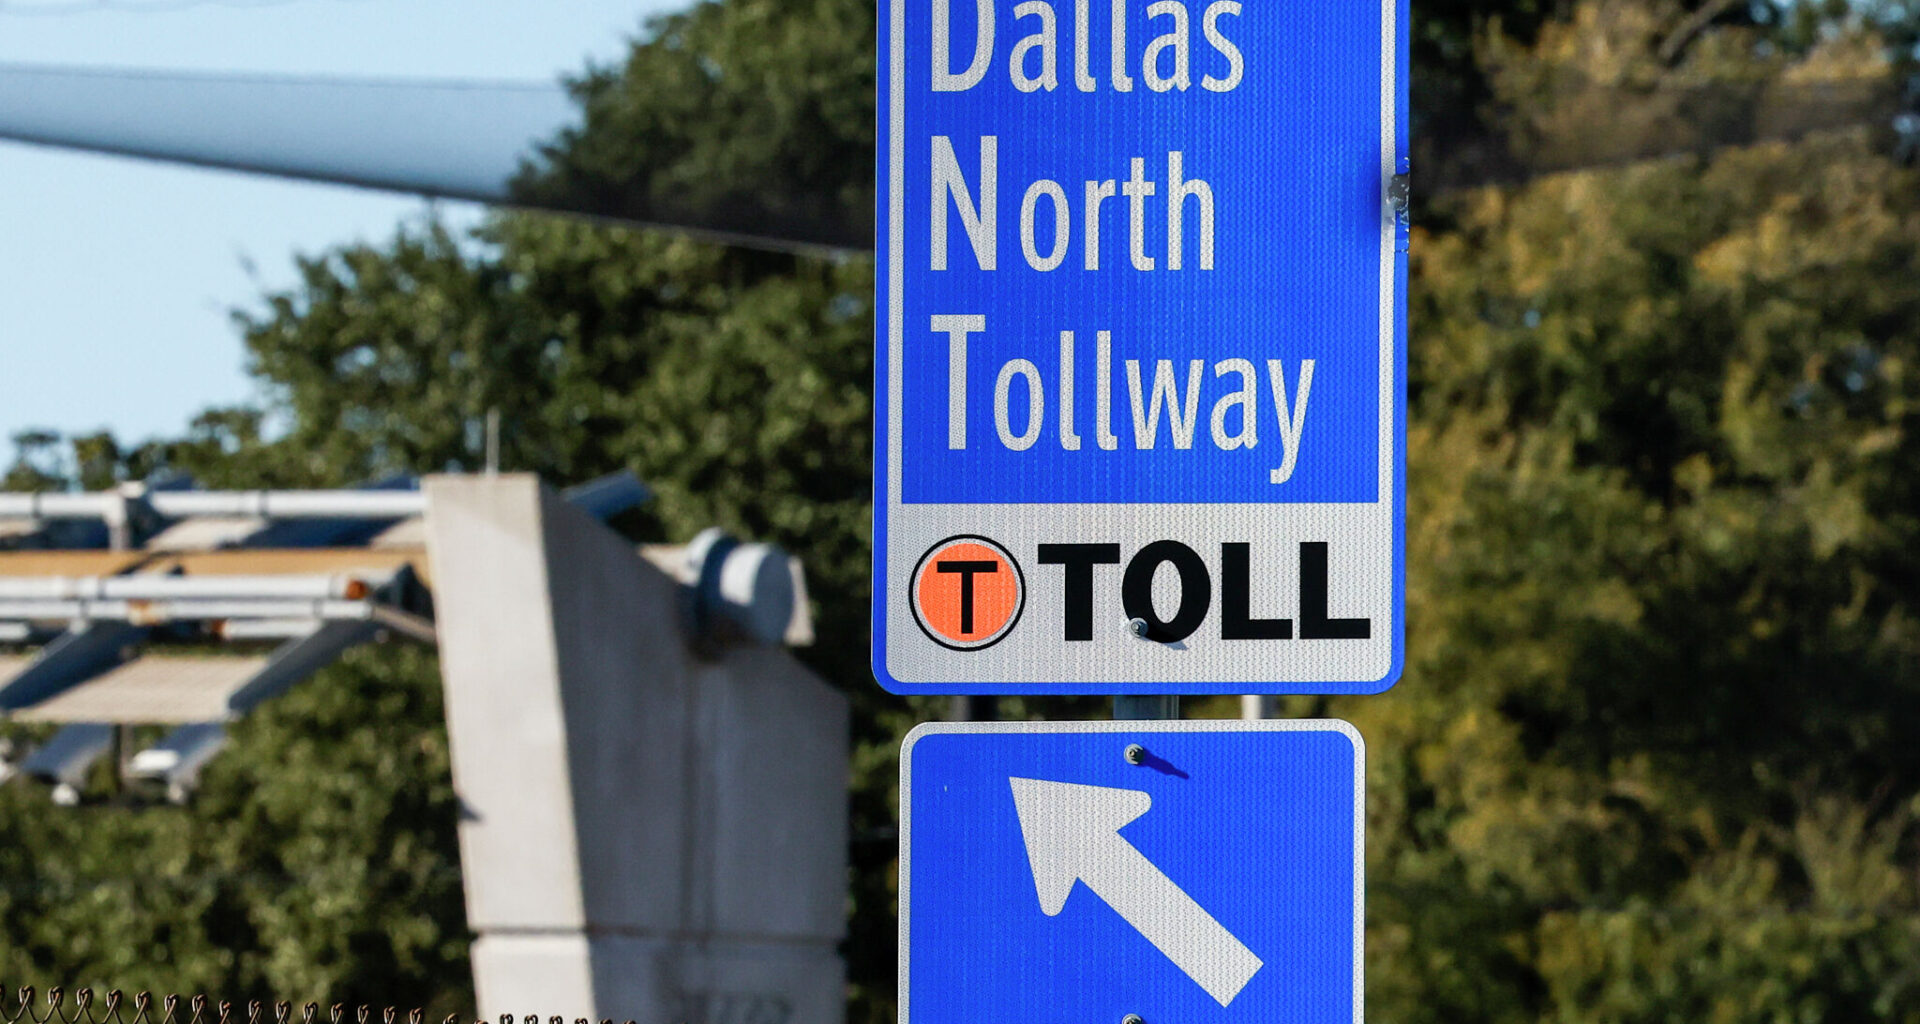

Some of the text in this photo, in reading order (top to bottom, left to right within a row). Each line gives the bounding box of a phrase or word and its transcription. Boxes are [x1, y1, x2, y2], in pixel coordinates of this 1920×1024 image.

[931, 0, 1244, 93] Dallas
[930, 135, 1215, 272] North
[930, 314, 1316, 484] Tollway
[937, 539, 1371, 643] T TOLL
